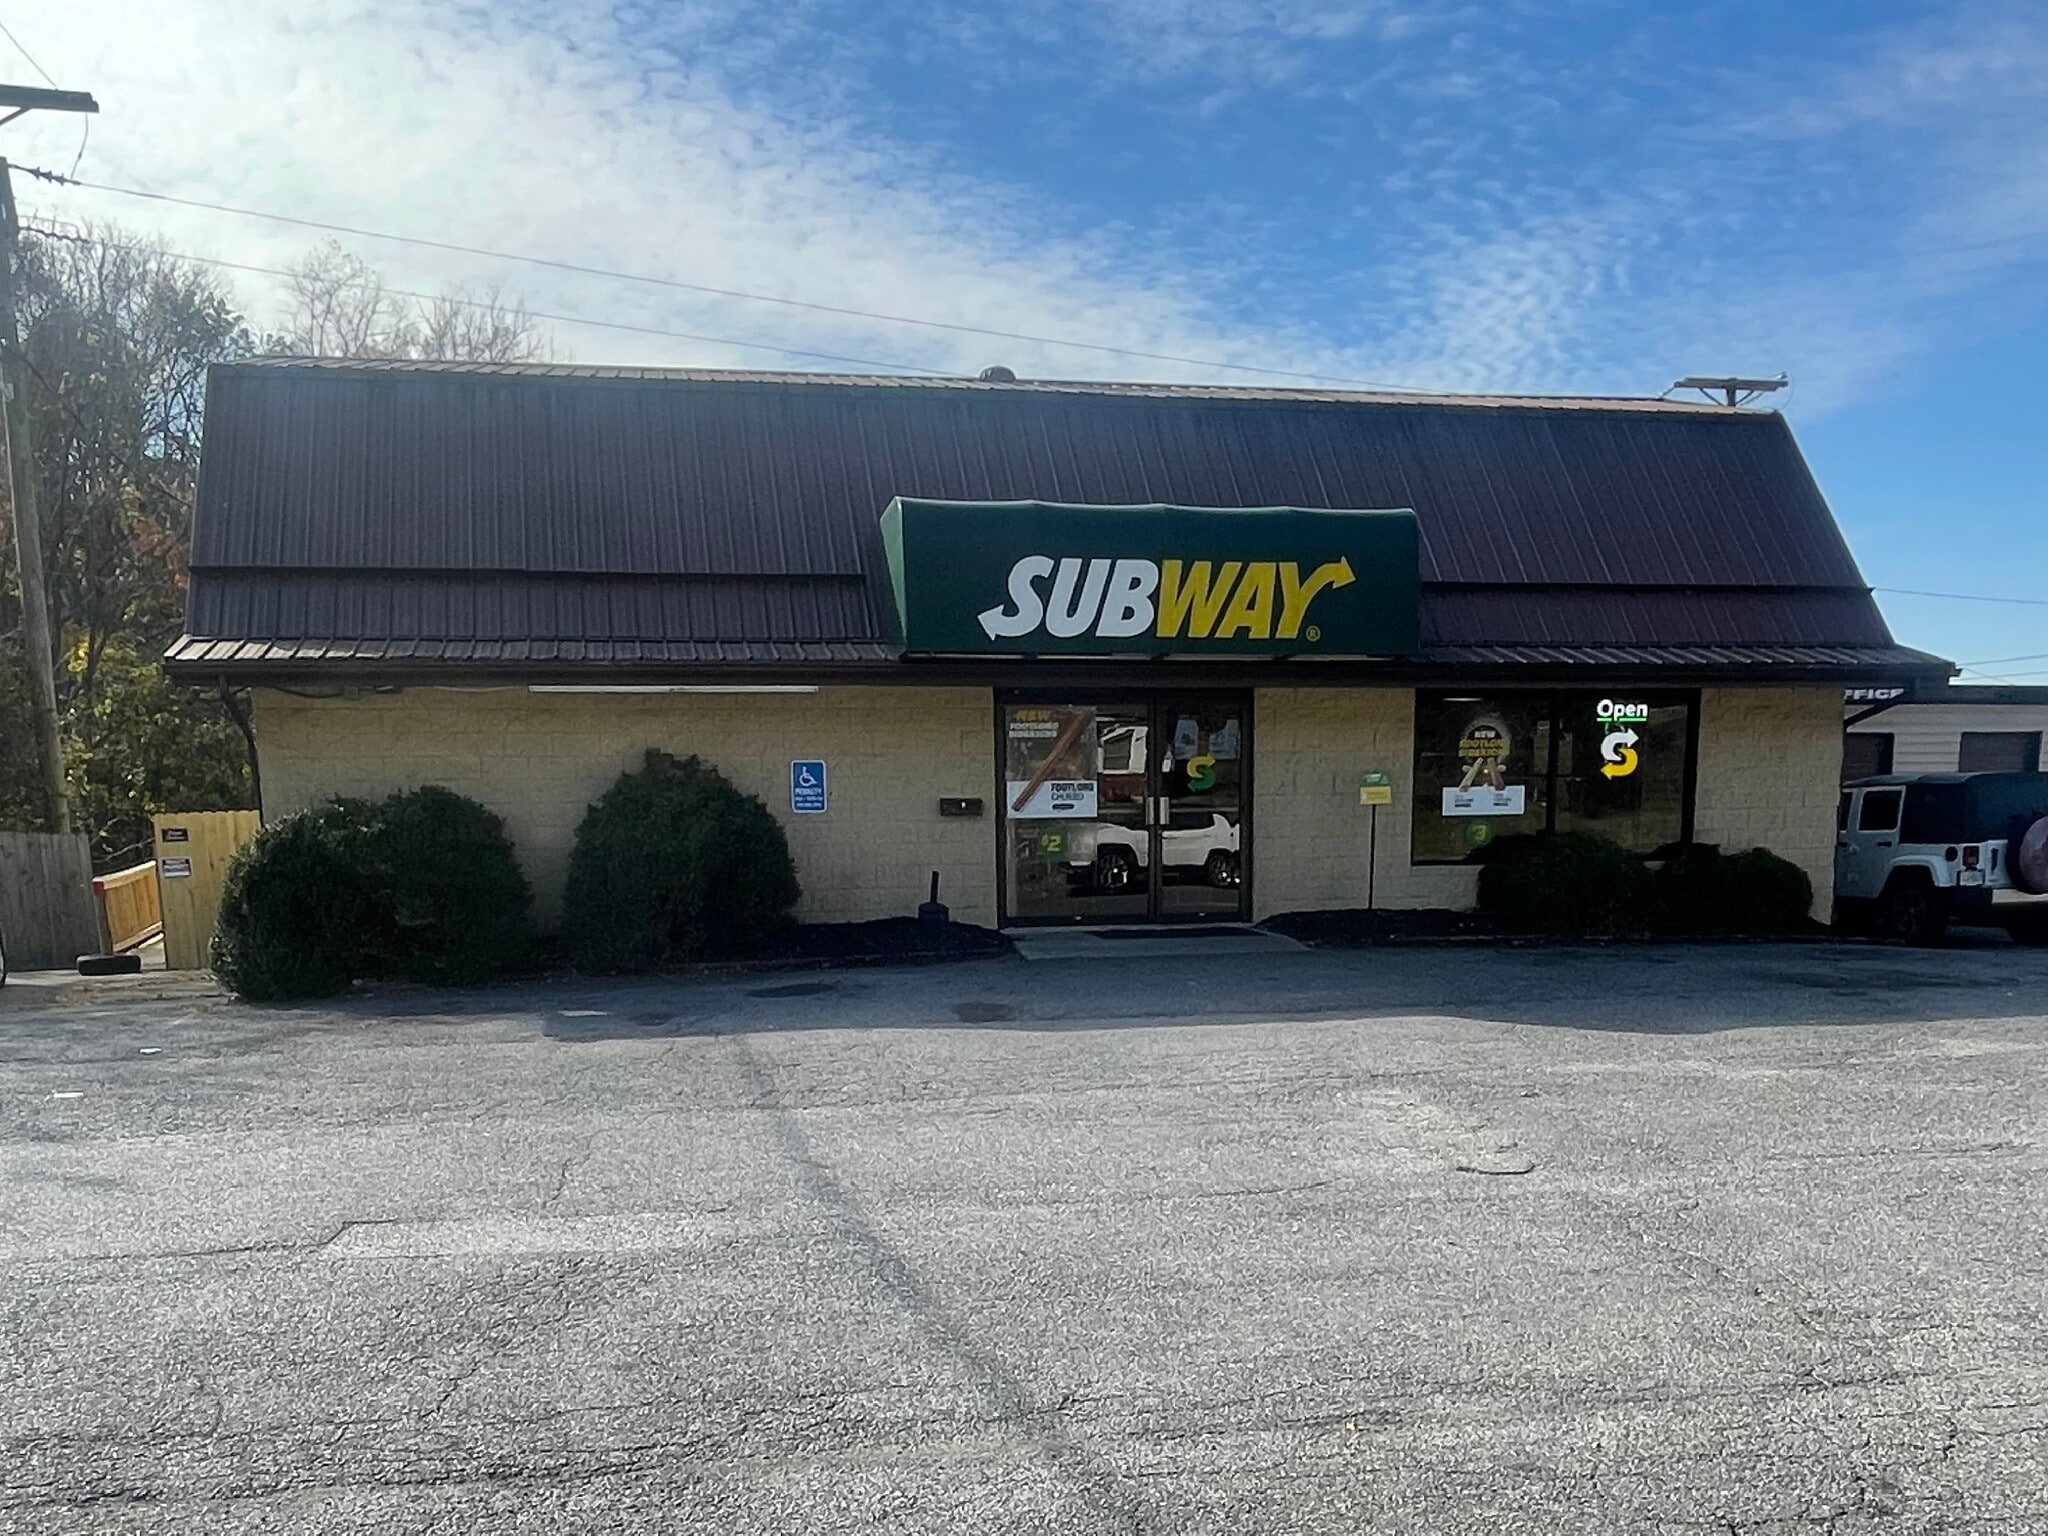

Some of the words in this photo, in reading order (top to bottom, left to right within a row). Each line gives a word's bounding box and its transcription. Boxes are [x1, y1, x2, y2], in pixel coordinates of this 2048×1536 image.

[977, 555, 1356, 640] SUBWAY
[1596, 699, 1648, 721] Open
[1474, 730, 1496, 738] NEW
